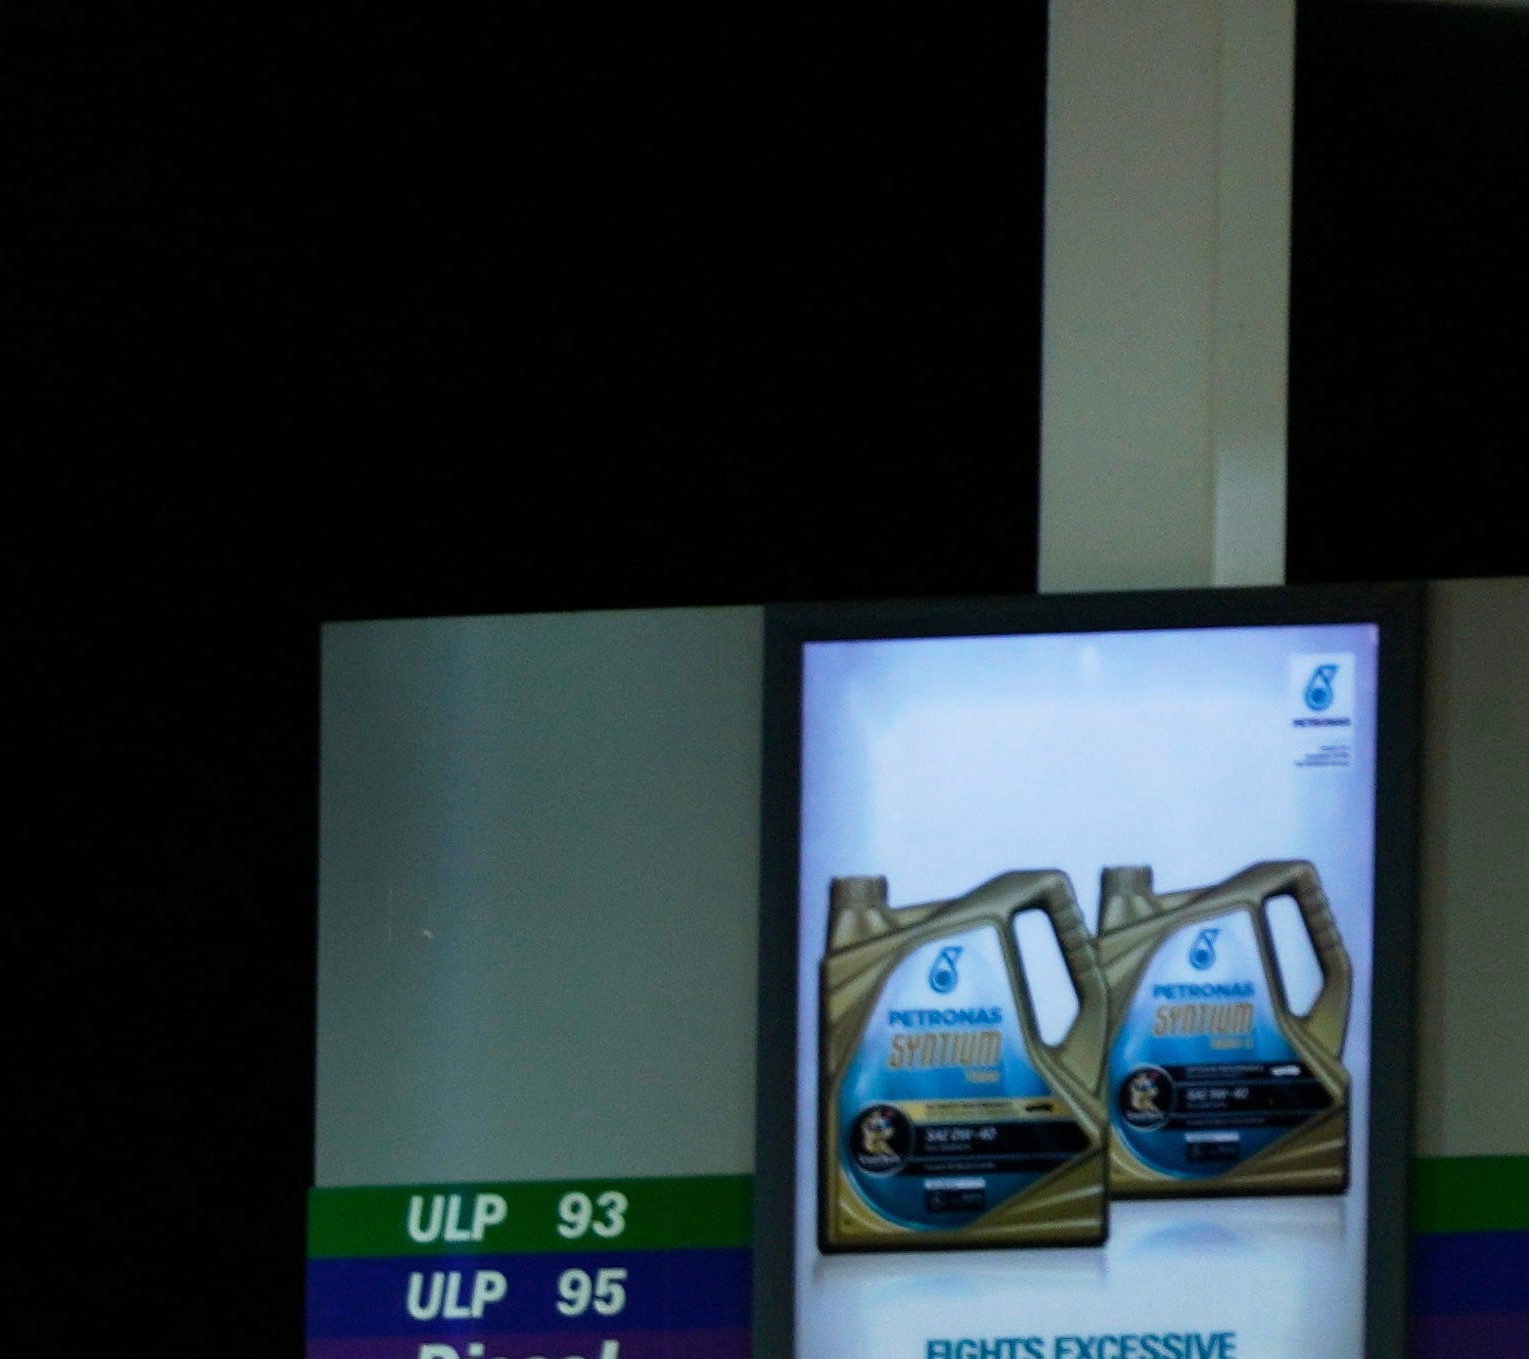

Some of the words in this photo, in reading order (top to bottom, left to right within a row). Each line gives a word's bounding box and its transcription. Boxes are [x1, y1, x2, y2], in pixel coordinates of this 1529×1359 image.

[889, 1007, 1003, 1027] PETRONAS
[407, 1194, 508, 1243] ULP
[557, 1191, 630, 1240] 93
[407, 1272, 508, 1320] ULP
[557, 1269, 628, 1318] 95
